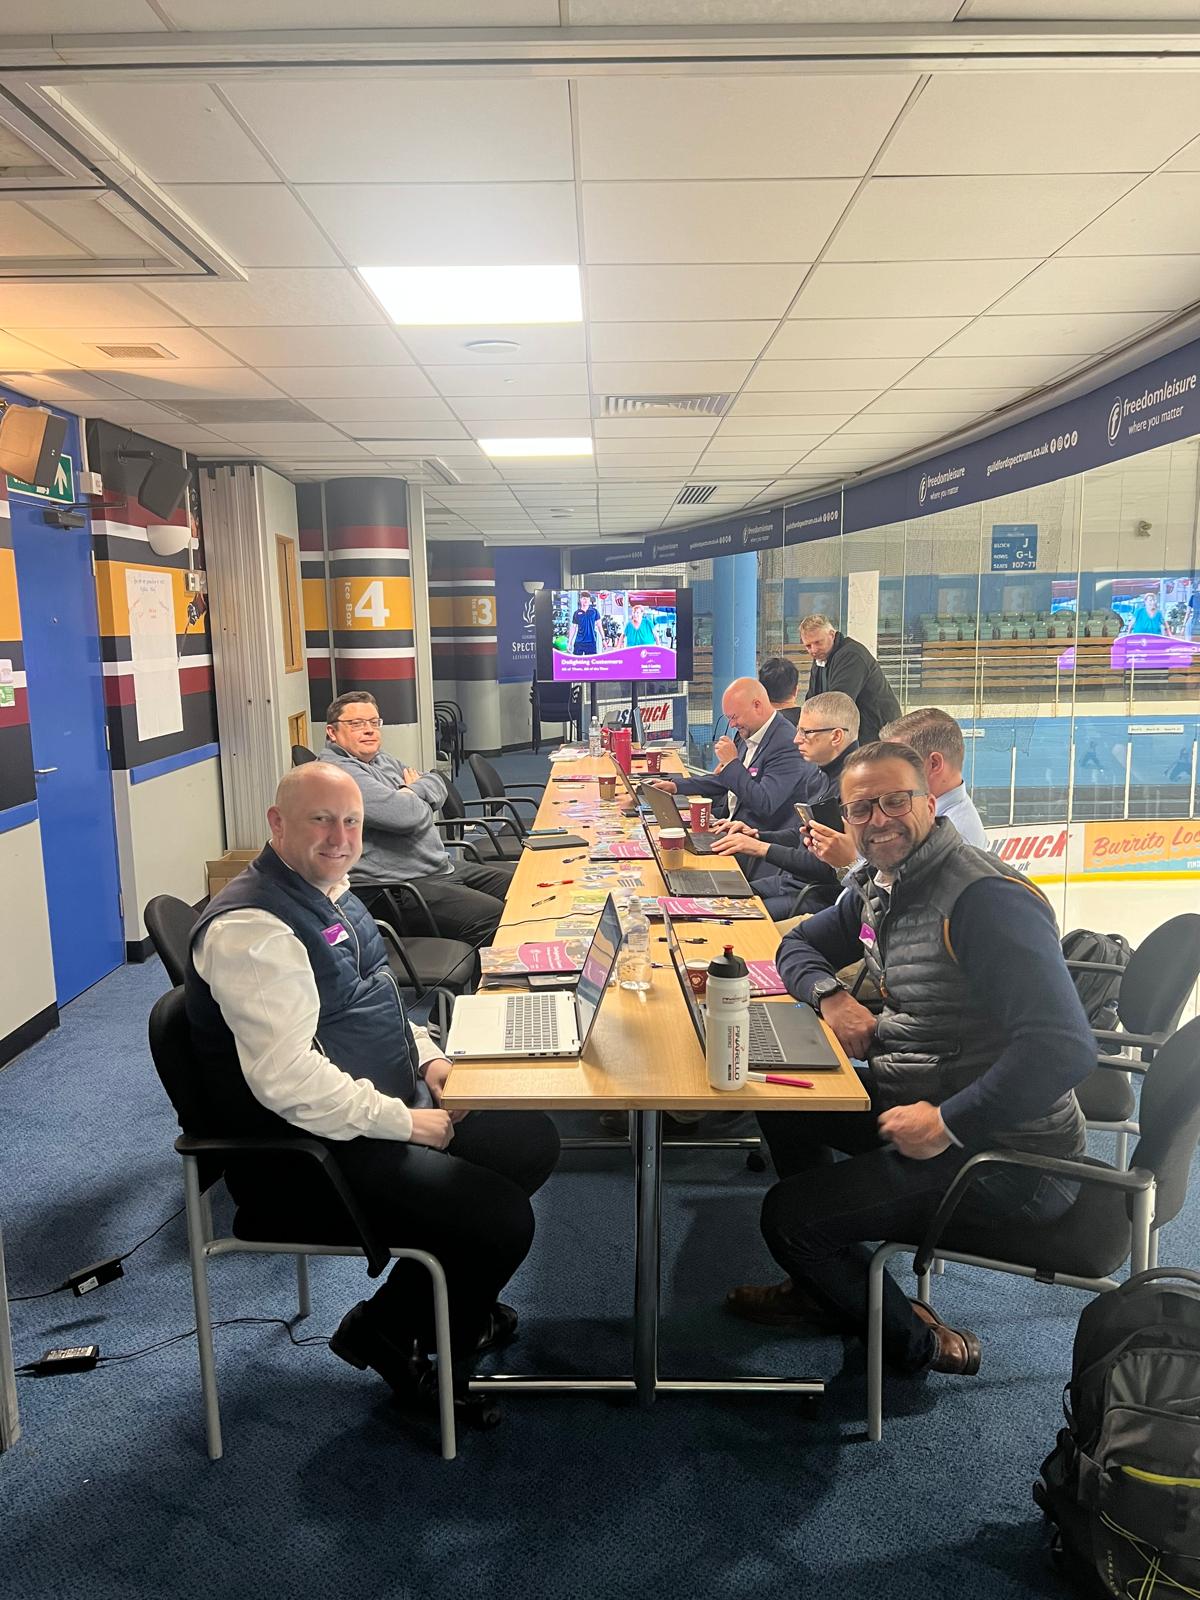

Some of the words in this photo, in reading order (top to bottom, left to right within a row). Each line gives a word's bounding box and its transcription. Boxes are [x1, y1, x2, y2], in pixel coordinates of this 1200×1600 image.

[1122, 373, 1197, 417] freedomleisure
[1128, 417, 1147, 435] where
[1147, 414, 1160, 431] you
[1160, 405, 1184, 423] matter
[986, 442, 1049, 477] guildfordspectrum.co.uk
[927, 466, 966, 488] freedomleisure
[1016, 550, 1034, 559] G-L
[1022, 538, 1029, 548] J
[354, 581, 390, 627] 4
[478, 598, 493, 625] 3
[512, 641, 536, 652] SPECT
[1092, 832, 1165, 856] Burrito
